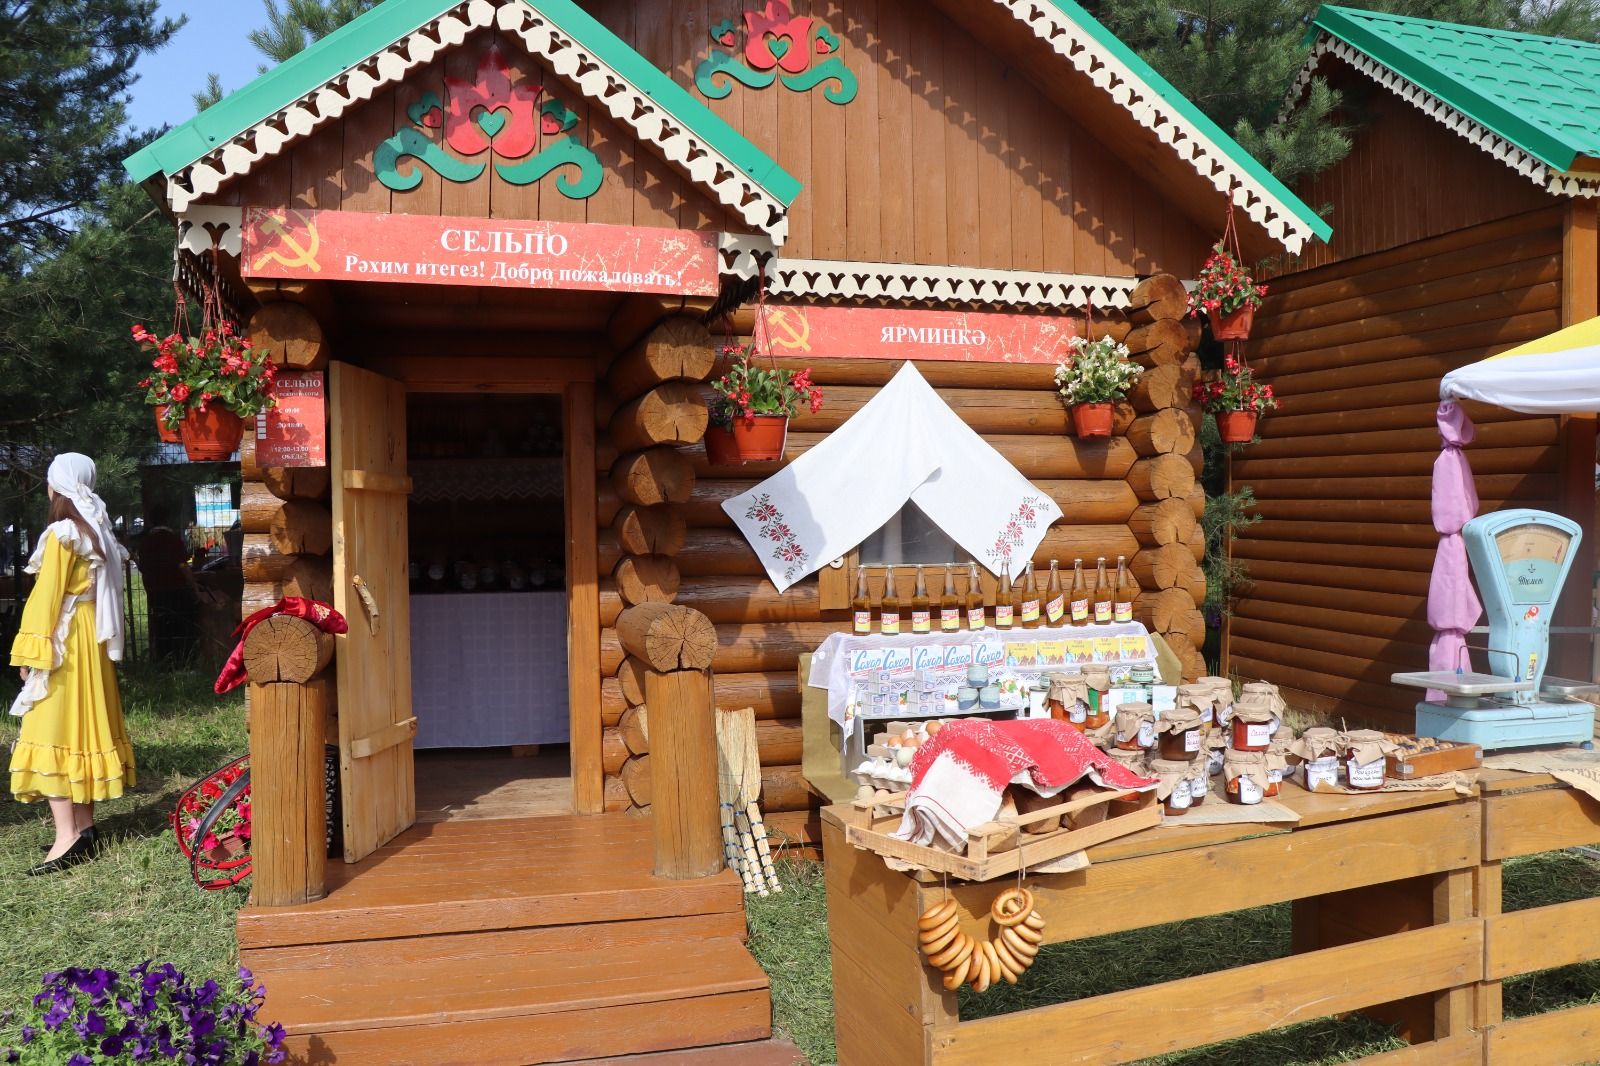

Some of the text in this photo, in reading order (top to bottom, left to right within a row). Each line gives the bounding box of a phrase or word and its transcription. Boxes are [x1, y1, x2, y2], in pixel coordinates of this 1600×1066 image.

[440, 229, 568, 256] СЕЛЬПО
[345, 255, 683, 287] Рәхим итегез! Добро пожаловать!
[880, 326, 987, 346] ЯРМИНКӘ
[276, 379, 321, 388] СЕЛЬПО
[854, 650, 882, 672] Сахар
[883, 649, 910, 671] Сахар
[915, 648, 942, 670] Сахар
[944, 646, 971, 669] Сахар
[975, 643, 1002, 664] Сахар
